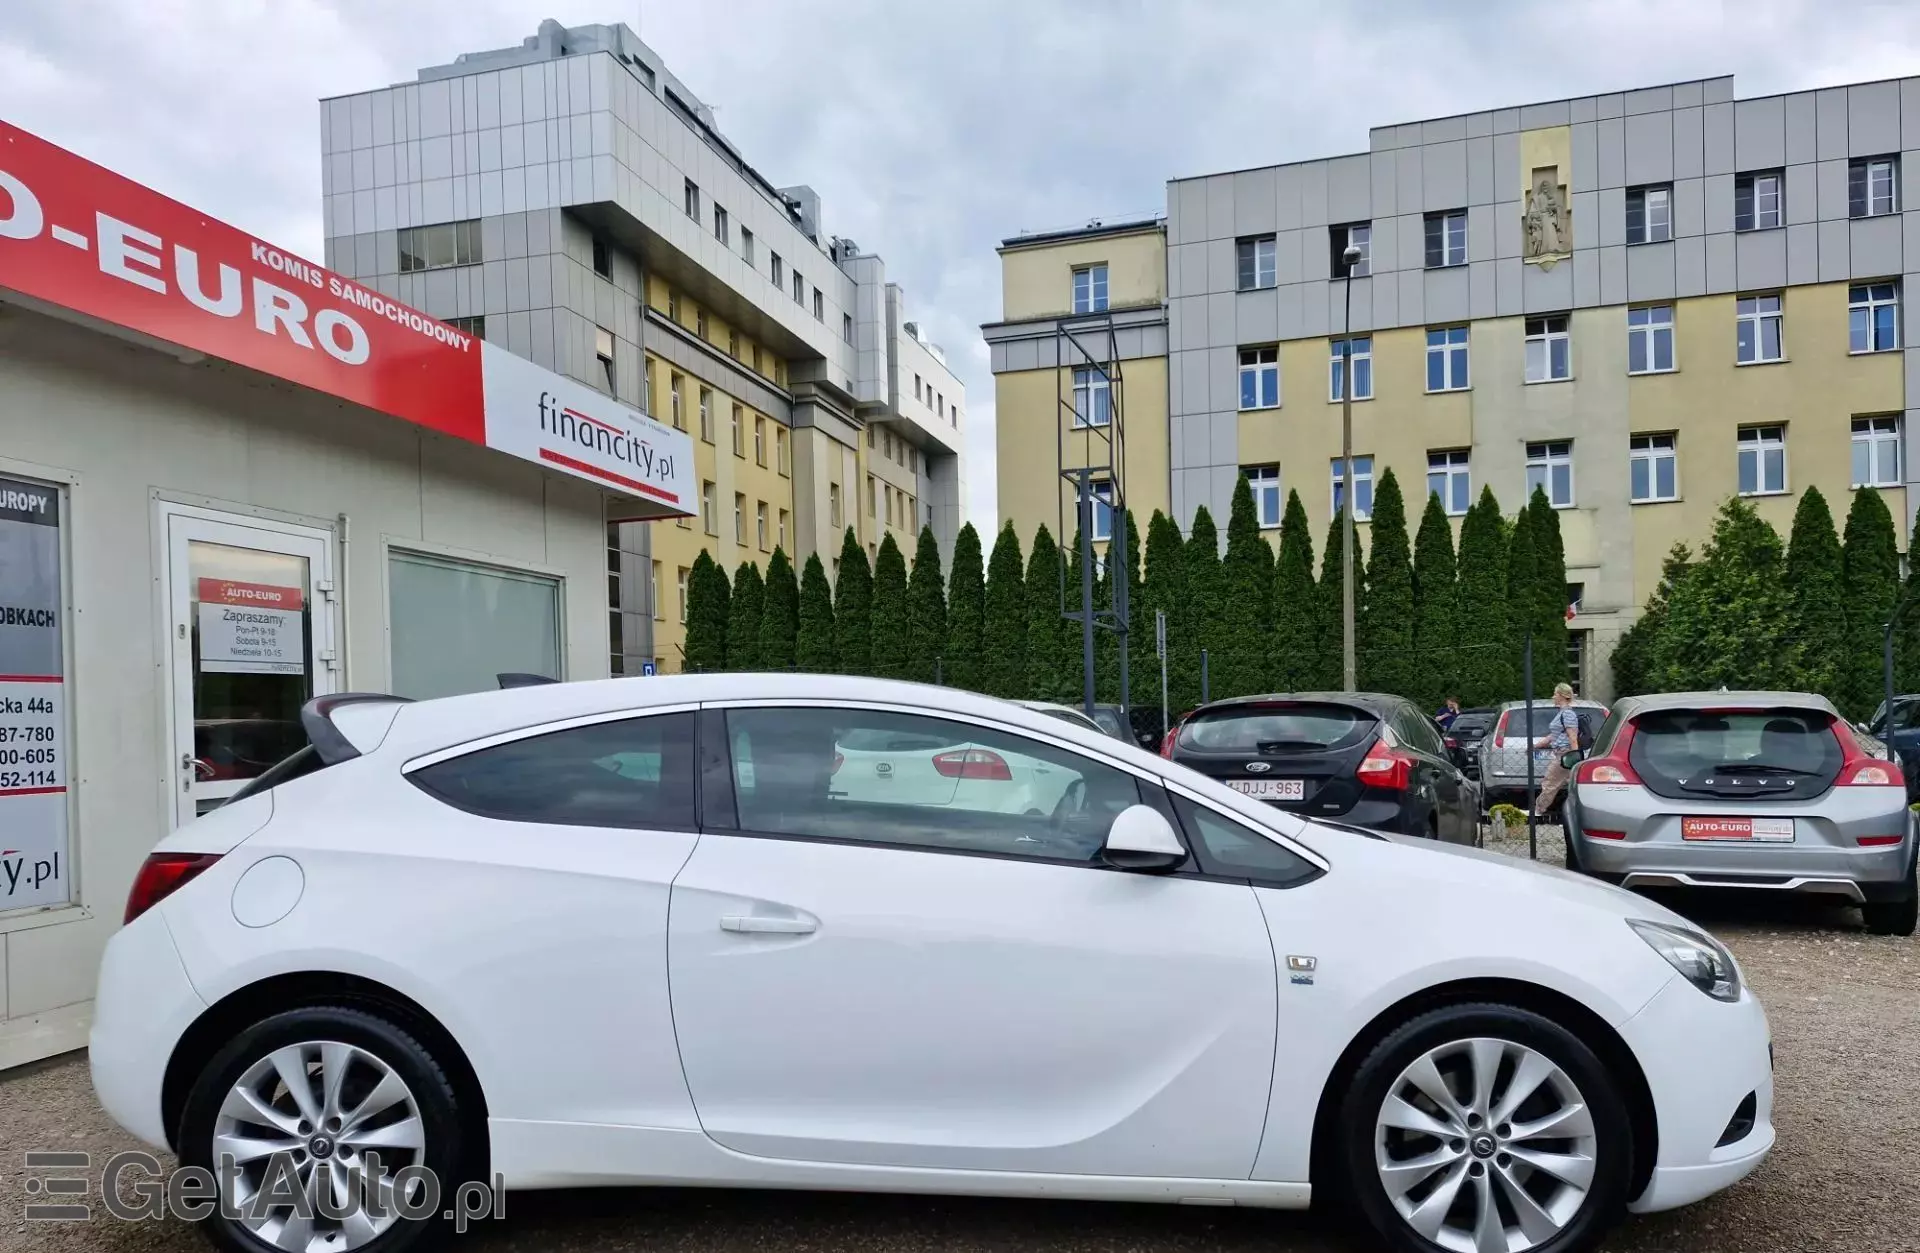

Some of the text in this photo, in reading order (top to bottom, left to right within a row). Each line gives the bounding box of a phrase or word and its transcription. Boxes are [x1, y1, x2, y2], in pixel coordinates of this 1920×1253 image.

[251, 242, 471, 352] KOMIS SAMOCHODOWY
[538, 392, 675, 482] financity.pl
[226, 588, 282, 602] AUTO-EURO
[27, 697, 54, 714] 44a
[0, 771, 56, 787] 52-114
[1678, 778, 1796, 786] VOLVO
[1689, 823, 1751, 832] AUTO-EURO
[0, 851, 59, 896] y.pl
